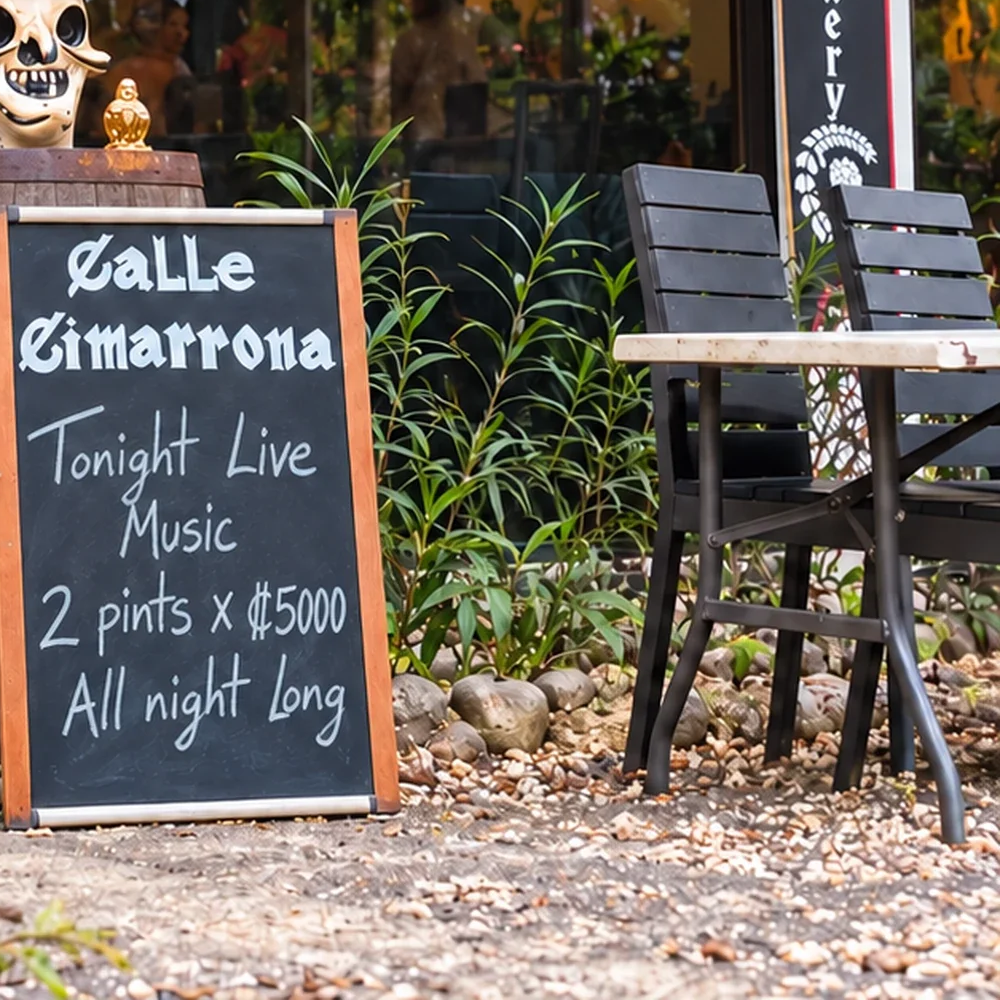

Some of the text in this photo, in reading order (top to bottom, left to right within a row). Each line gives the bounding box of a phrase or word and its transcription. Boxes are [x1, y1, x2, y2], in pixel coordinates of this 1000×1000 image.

[18, 311, 336, 374] Cimarrona
[27, 405, 317, 506] Tonight Live
[119, 499, 238, 560] Music
[39, 584, 80, 650] 2
[97, 571, 193, 656] pints
[62, 666, 125, 738] All
[145, 655, 251, 752] night
